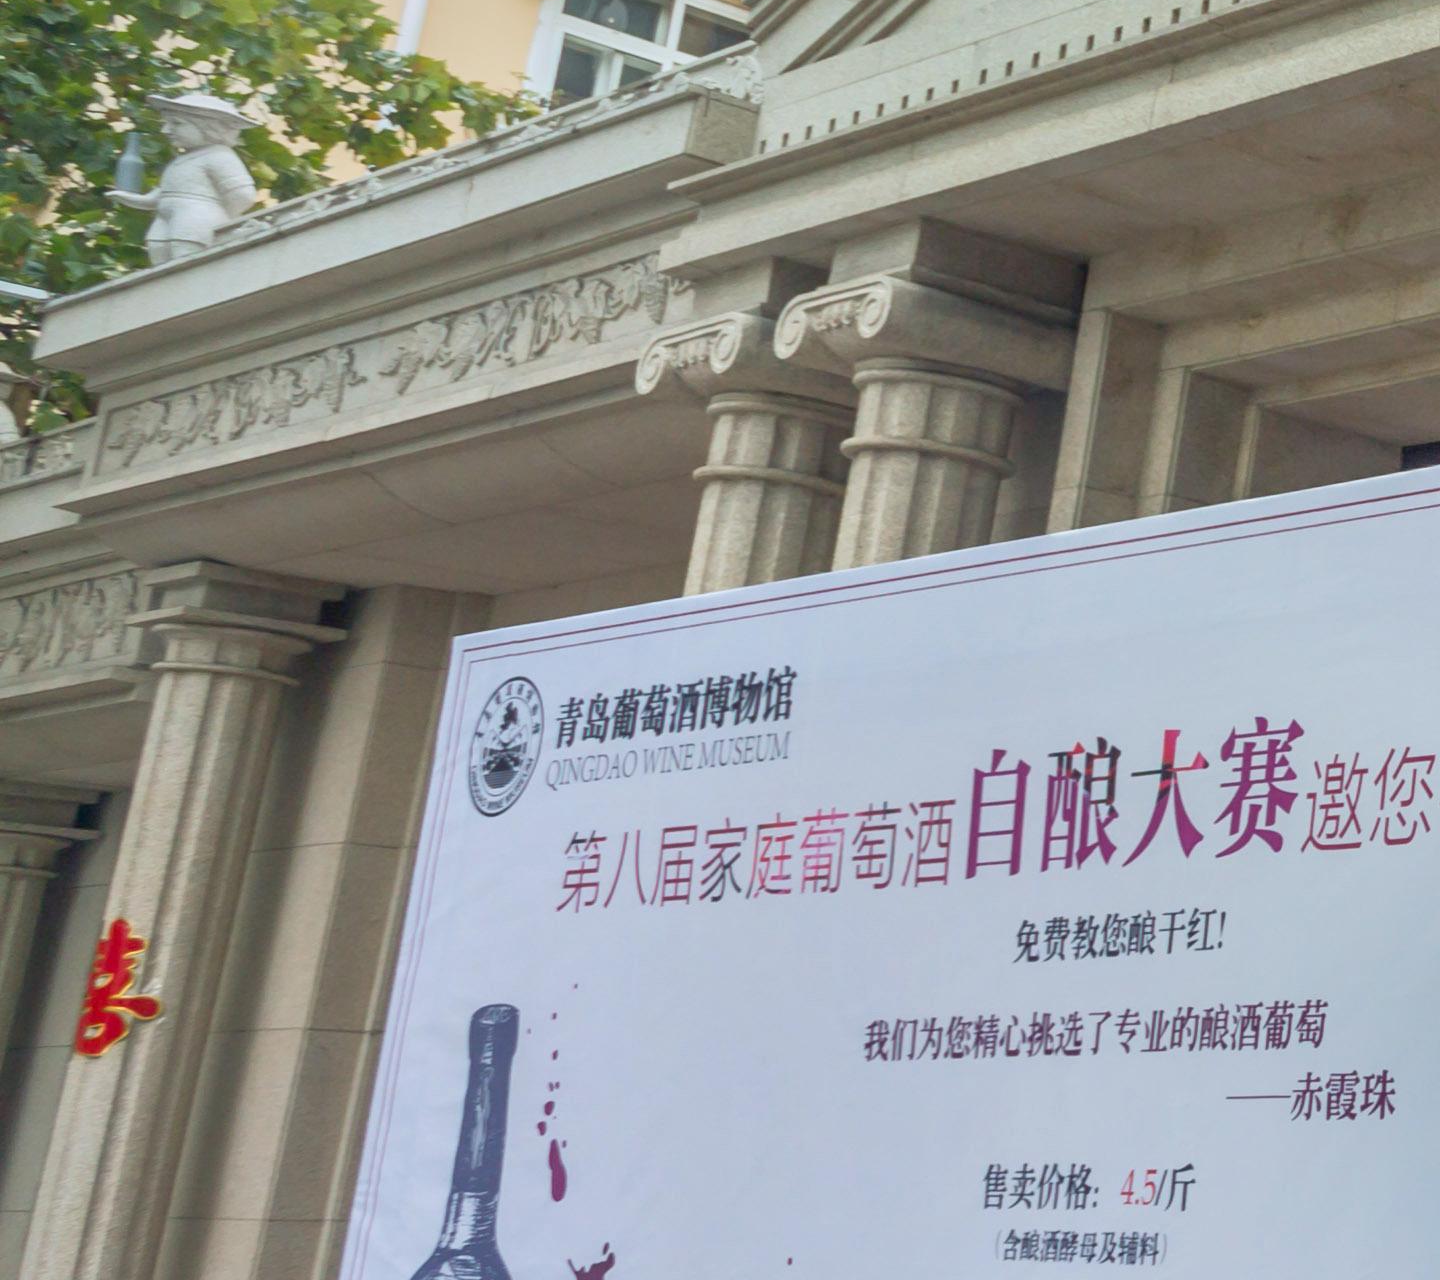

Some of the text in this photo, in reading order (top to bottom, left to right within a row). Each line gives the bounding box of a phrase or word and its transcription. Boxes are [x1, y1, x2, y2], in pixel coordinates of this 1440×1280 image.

[555, 665, 797, 749] 青岛葡萄酒博物馆
[545, 750, 639, 791] QINGDAO
[642, 742, 696, 775] WINE
[697, 731, 793, 770] MUSEUM
[863, 998, 1329, 1062] 我们为您精心挑选了专业的酿酒葡萄
